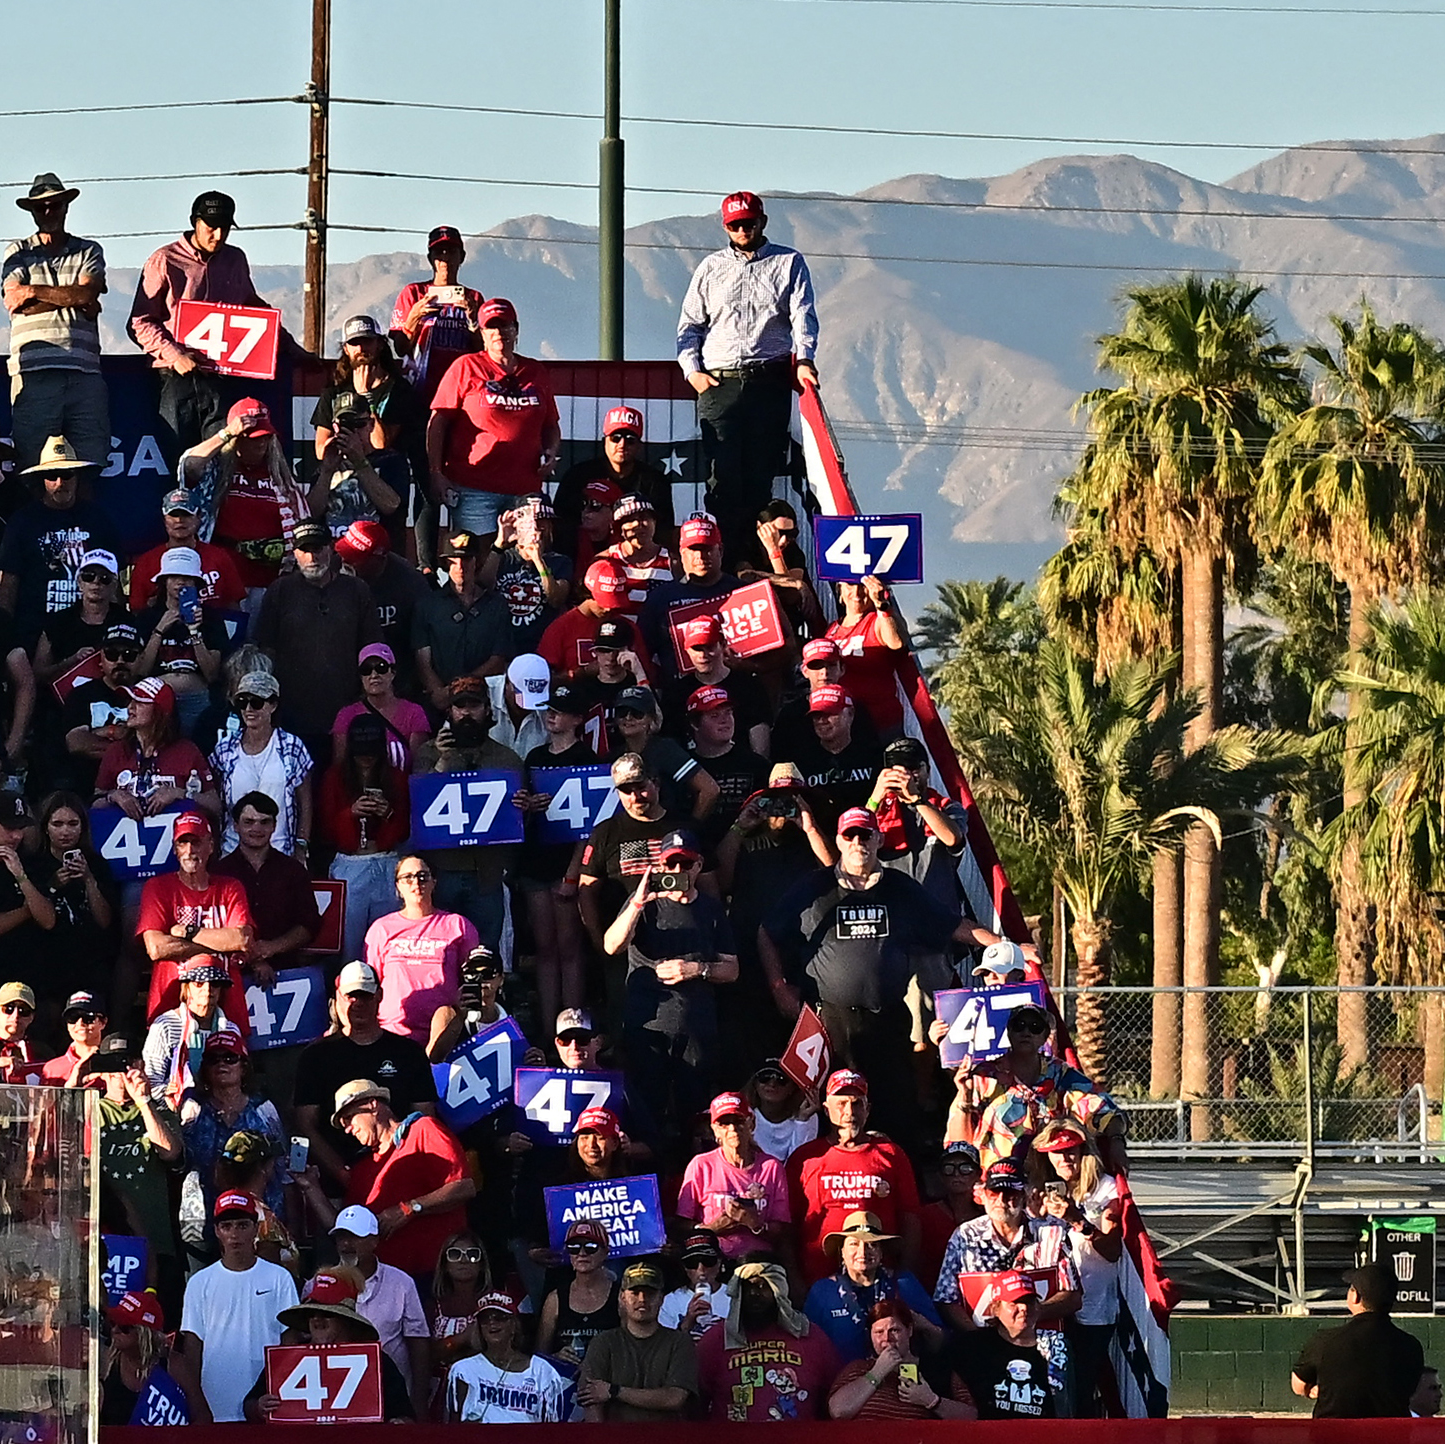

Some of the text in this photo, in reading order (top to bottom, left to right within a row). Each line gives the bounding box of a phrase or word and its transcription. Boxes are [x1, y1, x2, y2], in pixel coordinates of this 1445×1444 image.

[728, 201, 748, 213] USA
[184, 313, 267, 363] 47
[485, 395, 539, 406] VANCE
[611, 411, 639, 426] MAGA
[825, 525, 908, 574] 47
[423, 780, 507, 834] 47
[841, 909, 883, 920] TRUMP
[851, 925, 876, 935] 2024
[109, 1144, 139, 1156] 1776
[821, 1175, 881, 1189] TRUMP
[575, 1186, 627, 1205] MAKE
[831, 1189, 871, 1199] VANCE
[563, 1200, 646, 1222] AMERICA
[741, 1341, 785, 1351] SUPER
[727, 1348, 802, 1366] MARIO
[279, 1354, 368, 1410] 47
[479, 1387, 537, 1409] TRUMP
